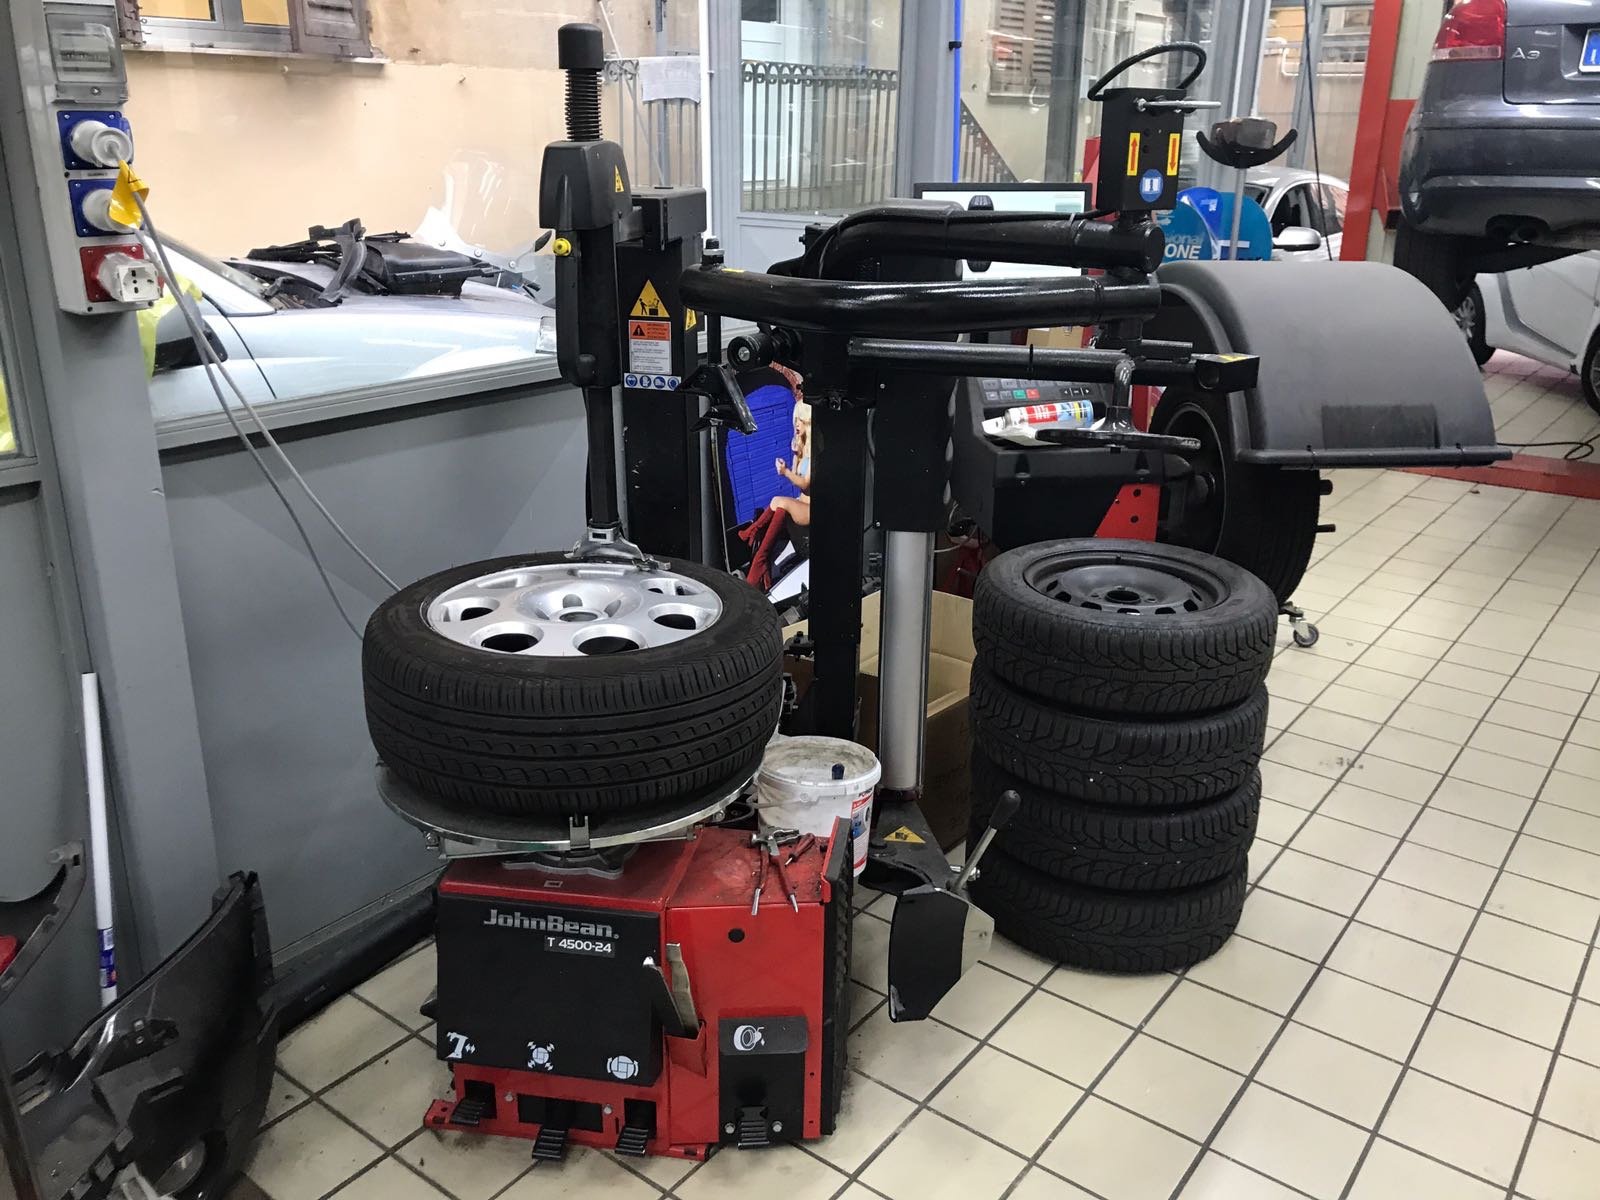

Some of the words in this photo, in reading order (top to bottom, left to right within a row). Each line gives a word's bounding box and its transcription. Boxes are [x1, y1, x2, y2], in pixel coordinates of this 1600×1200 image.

[1512, 47, 1541, 60] A3
[547, 937, 556, 948] T
[559, 938, 612, 953] 4500-24
